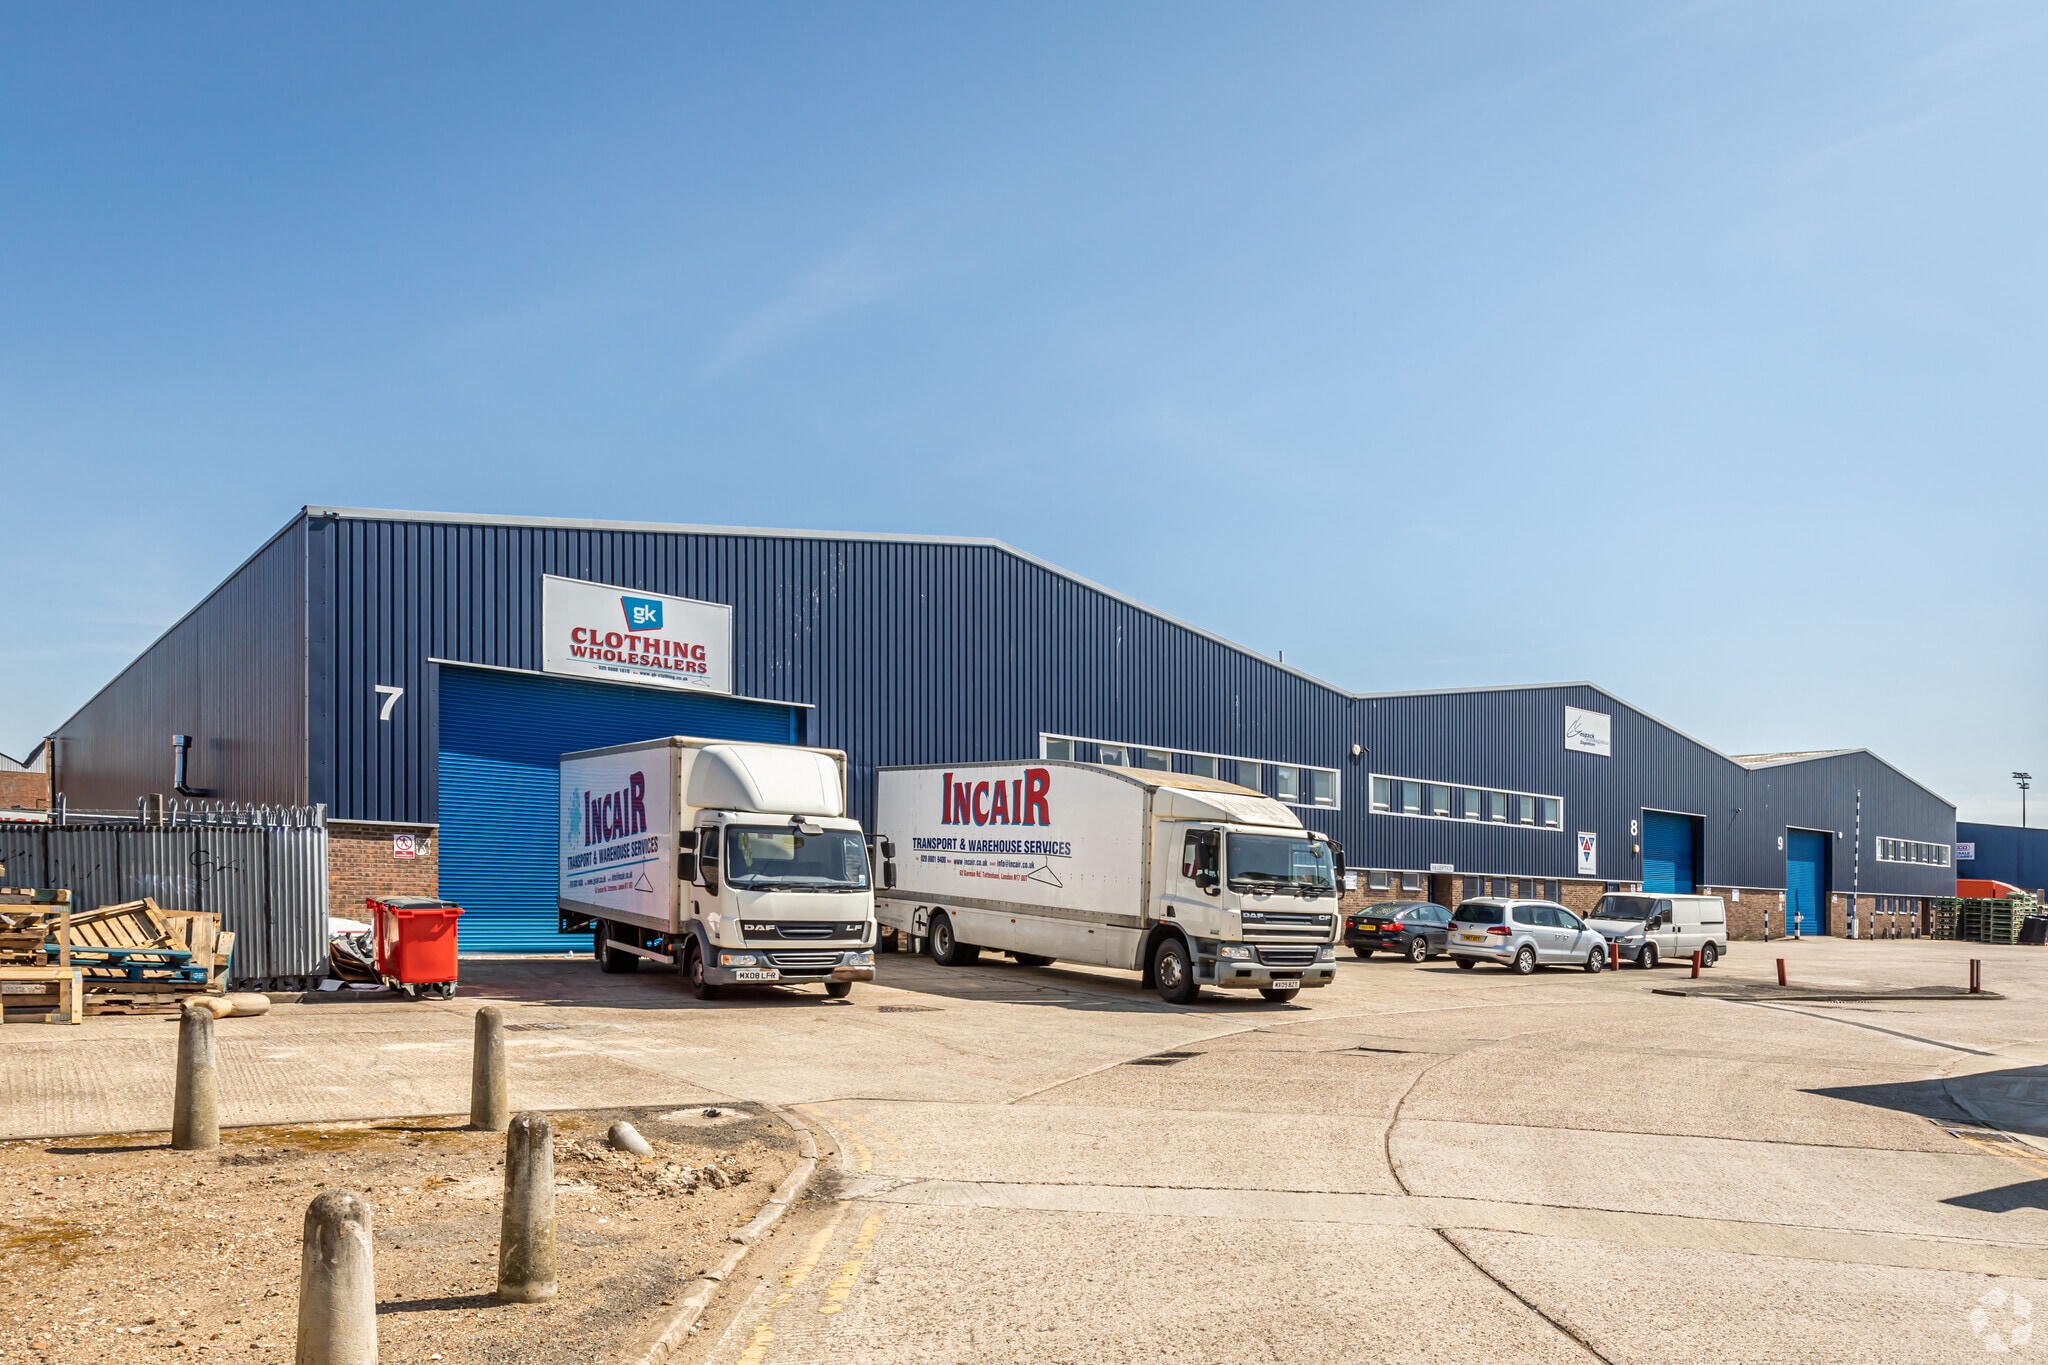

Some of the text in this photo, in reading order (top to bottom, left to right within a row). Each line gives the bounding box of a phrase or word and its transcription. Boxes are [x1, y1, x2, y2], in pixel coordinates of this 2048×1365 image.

[633, 605, 657, 624] gk
[570, 644, 708, 674] WHOLESALERS
[571, 626, 706, 661] CLOTHING
[375, 684, 404, 720] 7
[584, 771, 647, 846] INCAIR
[941, 768, 1051, 827] INCAIR
[1631, 820, 1637, 836] 8
[1777, 836, 1783, 850] 9
[567, 836, 658, 870] TRANSPORT & WAREHOUSE SERVICES
[913, 837, 1071, 856] TRANSPORT & WAREHOUSE SERVICES
